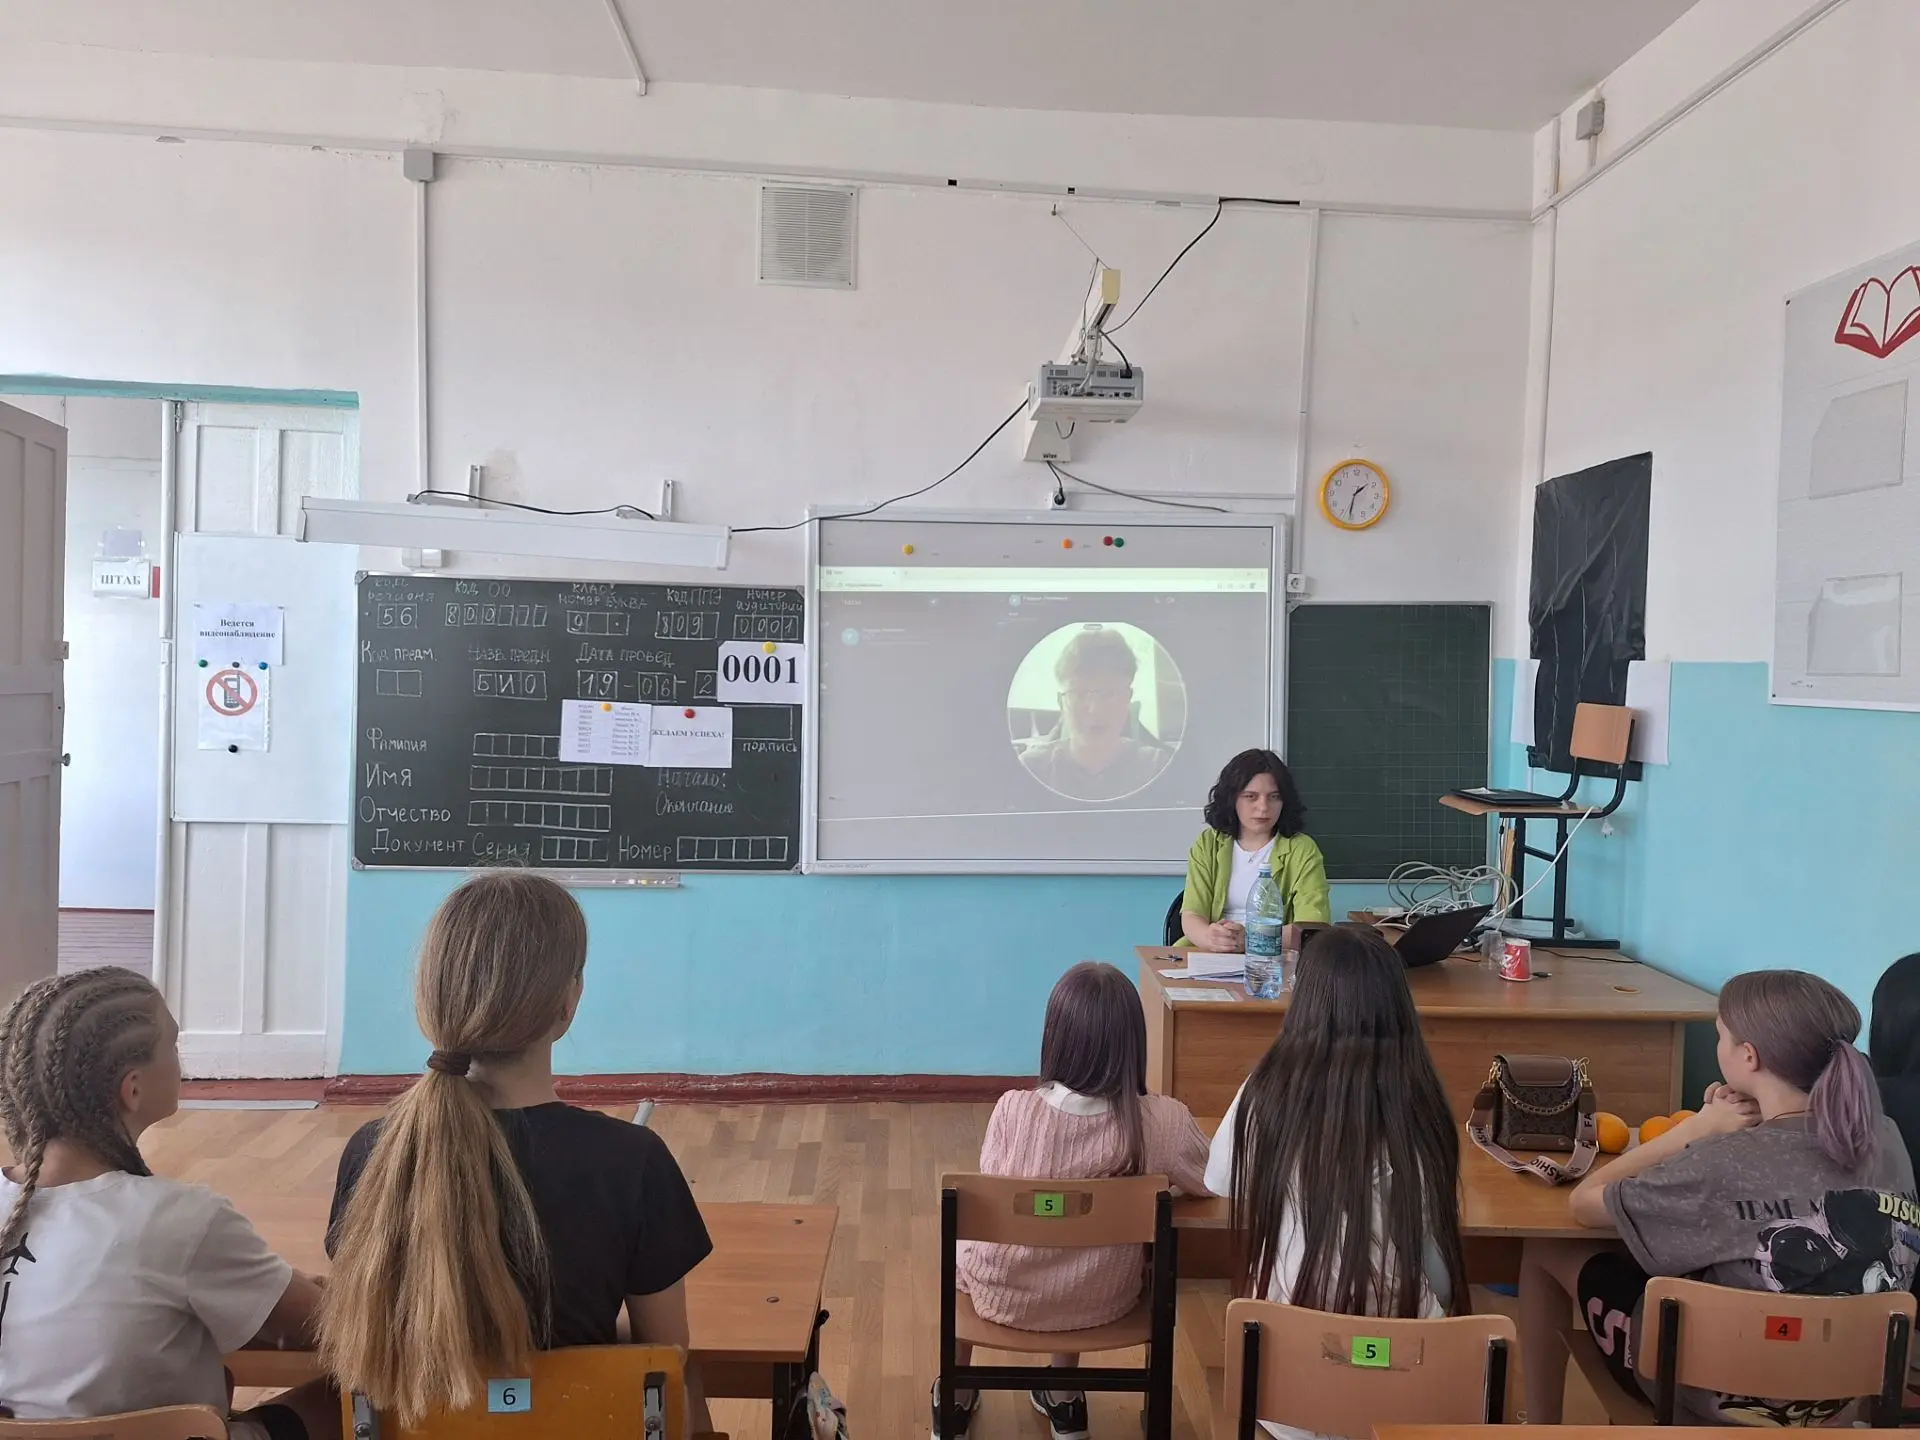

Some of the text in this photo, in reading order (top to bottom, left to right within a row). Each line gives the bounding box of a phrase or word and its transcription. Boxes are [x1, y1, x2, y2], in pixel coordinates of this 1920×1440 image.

[101, 574, 141, 585] ШТАБ
[220, 619, 254, 628] Ведется
[383, 607, 412, 626] 56
[199, 630, 276, 639] видеонаблюдение
[723, 654, 800, 684] 0001
[478, 674, 536, 694] БИО
[652, 729, 725, 738] ЖЕЛАЕМ УСПЕХА!
[366, 762, 412, 788] Имя
[360, 796, 451, 823] Отчество
[371, 828, 465, 854] Документ
[619, 835, 672, 861] Номер
[1044, 1199, 1054, 1212] 5
[1778, 1323, 1789, 1337] 4
[1365, 1343, 1377, 1359] 5
[502, 1387, 516, 1406] 6
